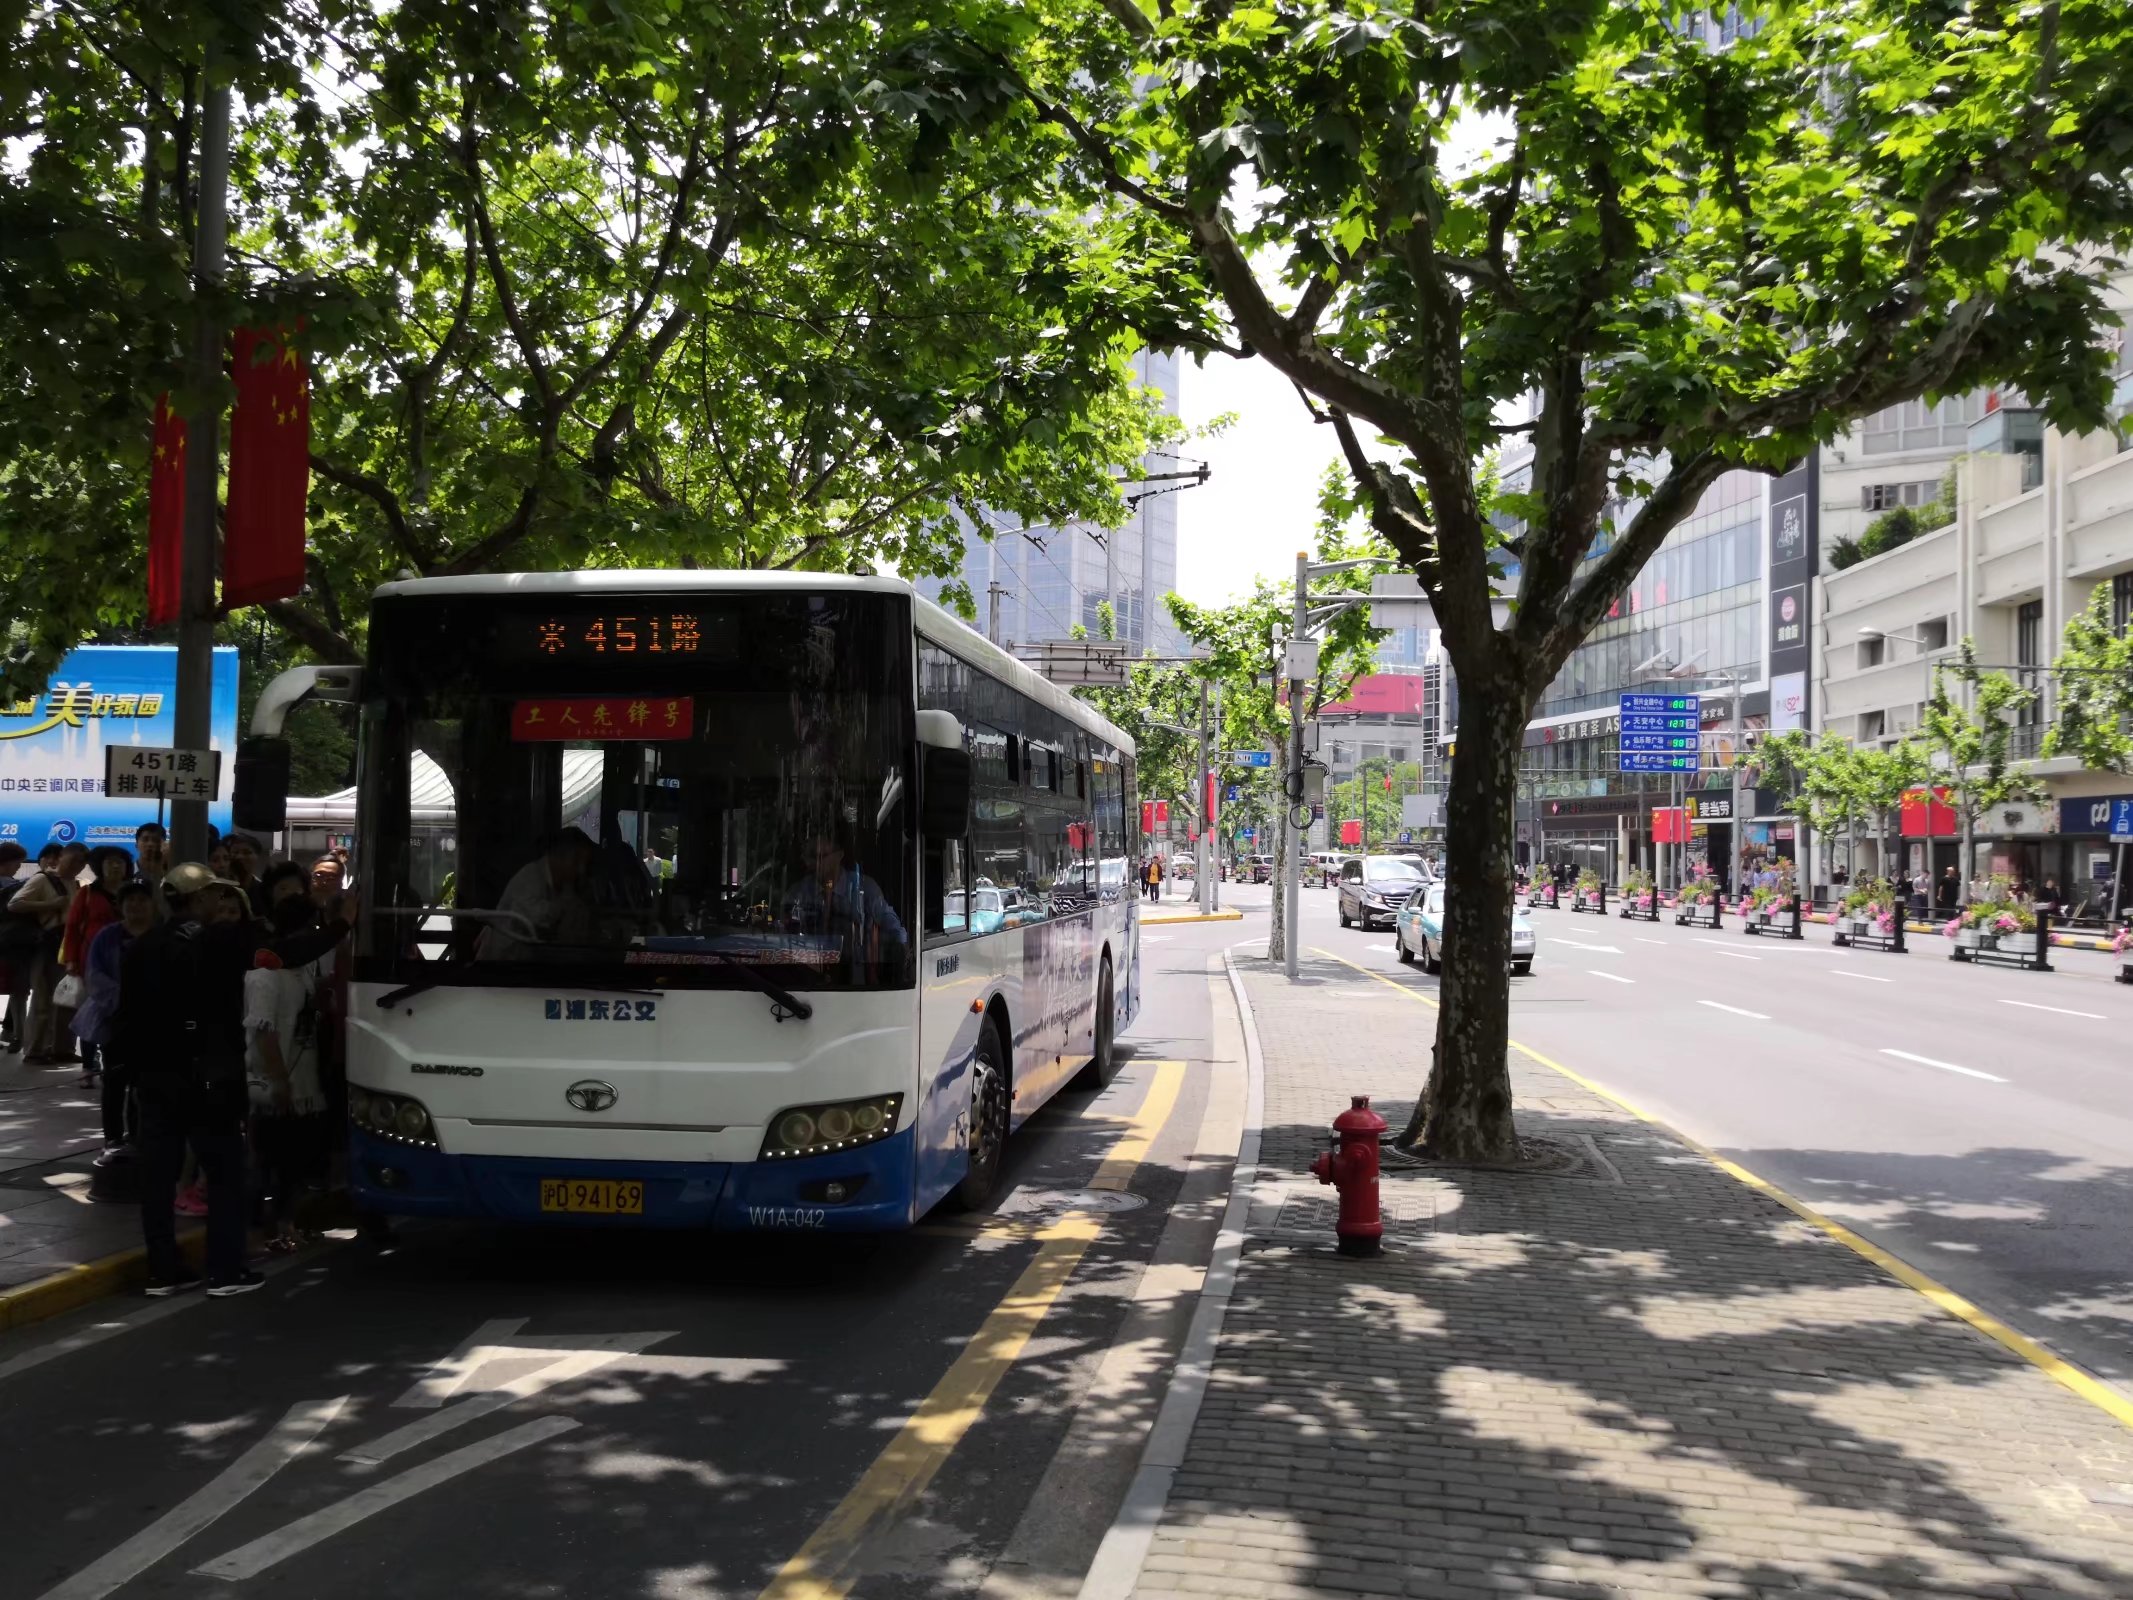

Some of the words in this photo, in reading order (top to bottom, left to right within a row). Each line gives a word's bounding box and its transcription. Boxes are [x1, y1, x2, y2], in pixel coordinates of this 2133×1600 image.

[46, 682, 164, 727] 美好家园
[524, 701, 680, 728] 工人先锋号
[131, 752, 197, 773] 451路
[118, 773, 210, 796] 排队上车
[1699, 800, 1730, 817] 麦当劳
[566, 999, 656, 1021] 浦东公交
[410, 1063, 484, 1077] DAEWOO
[749, 1206, 825, 1228] W1A-042
